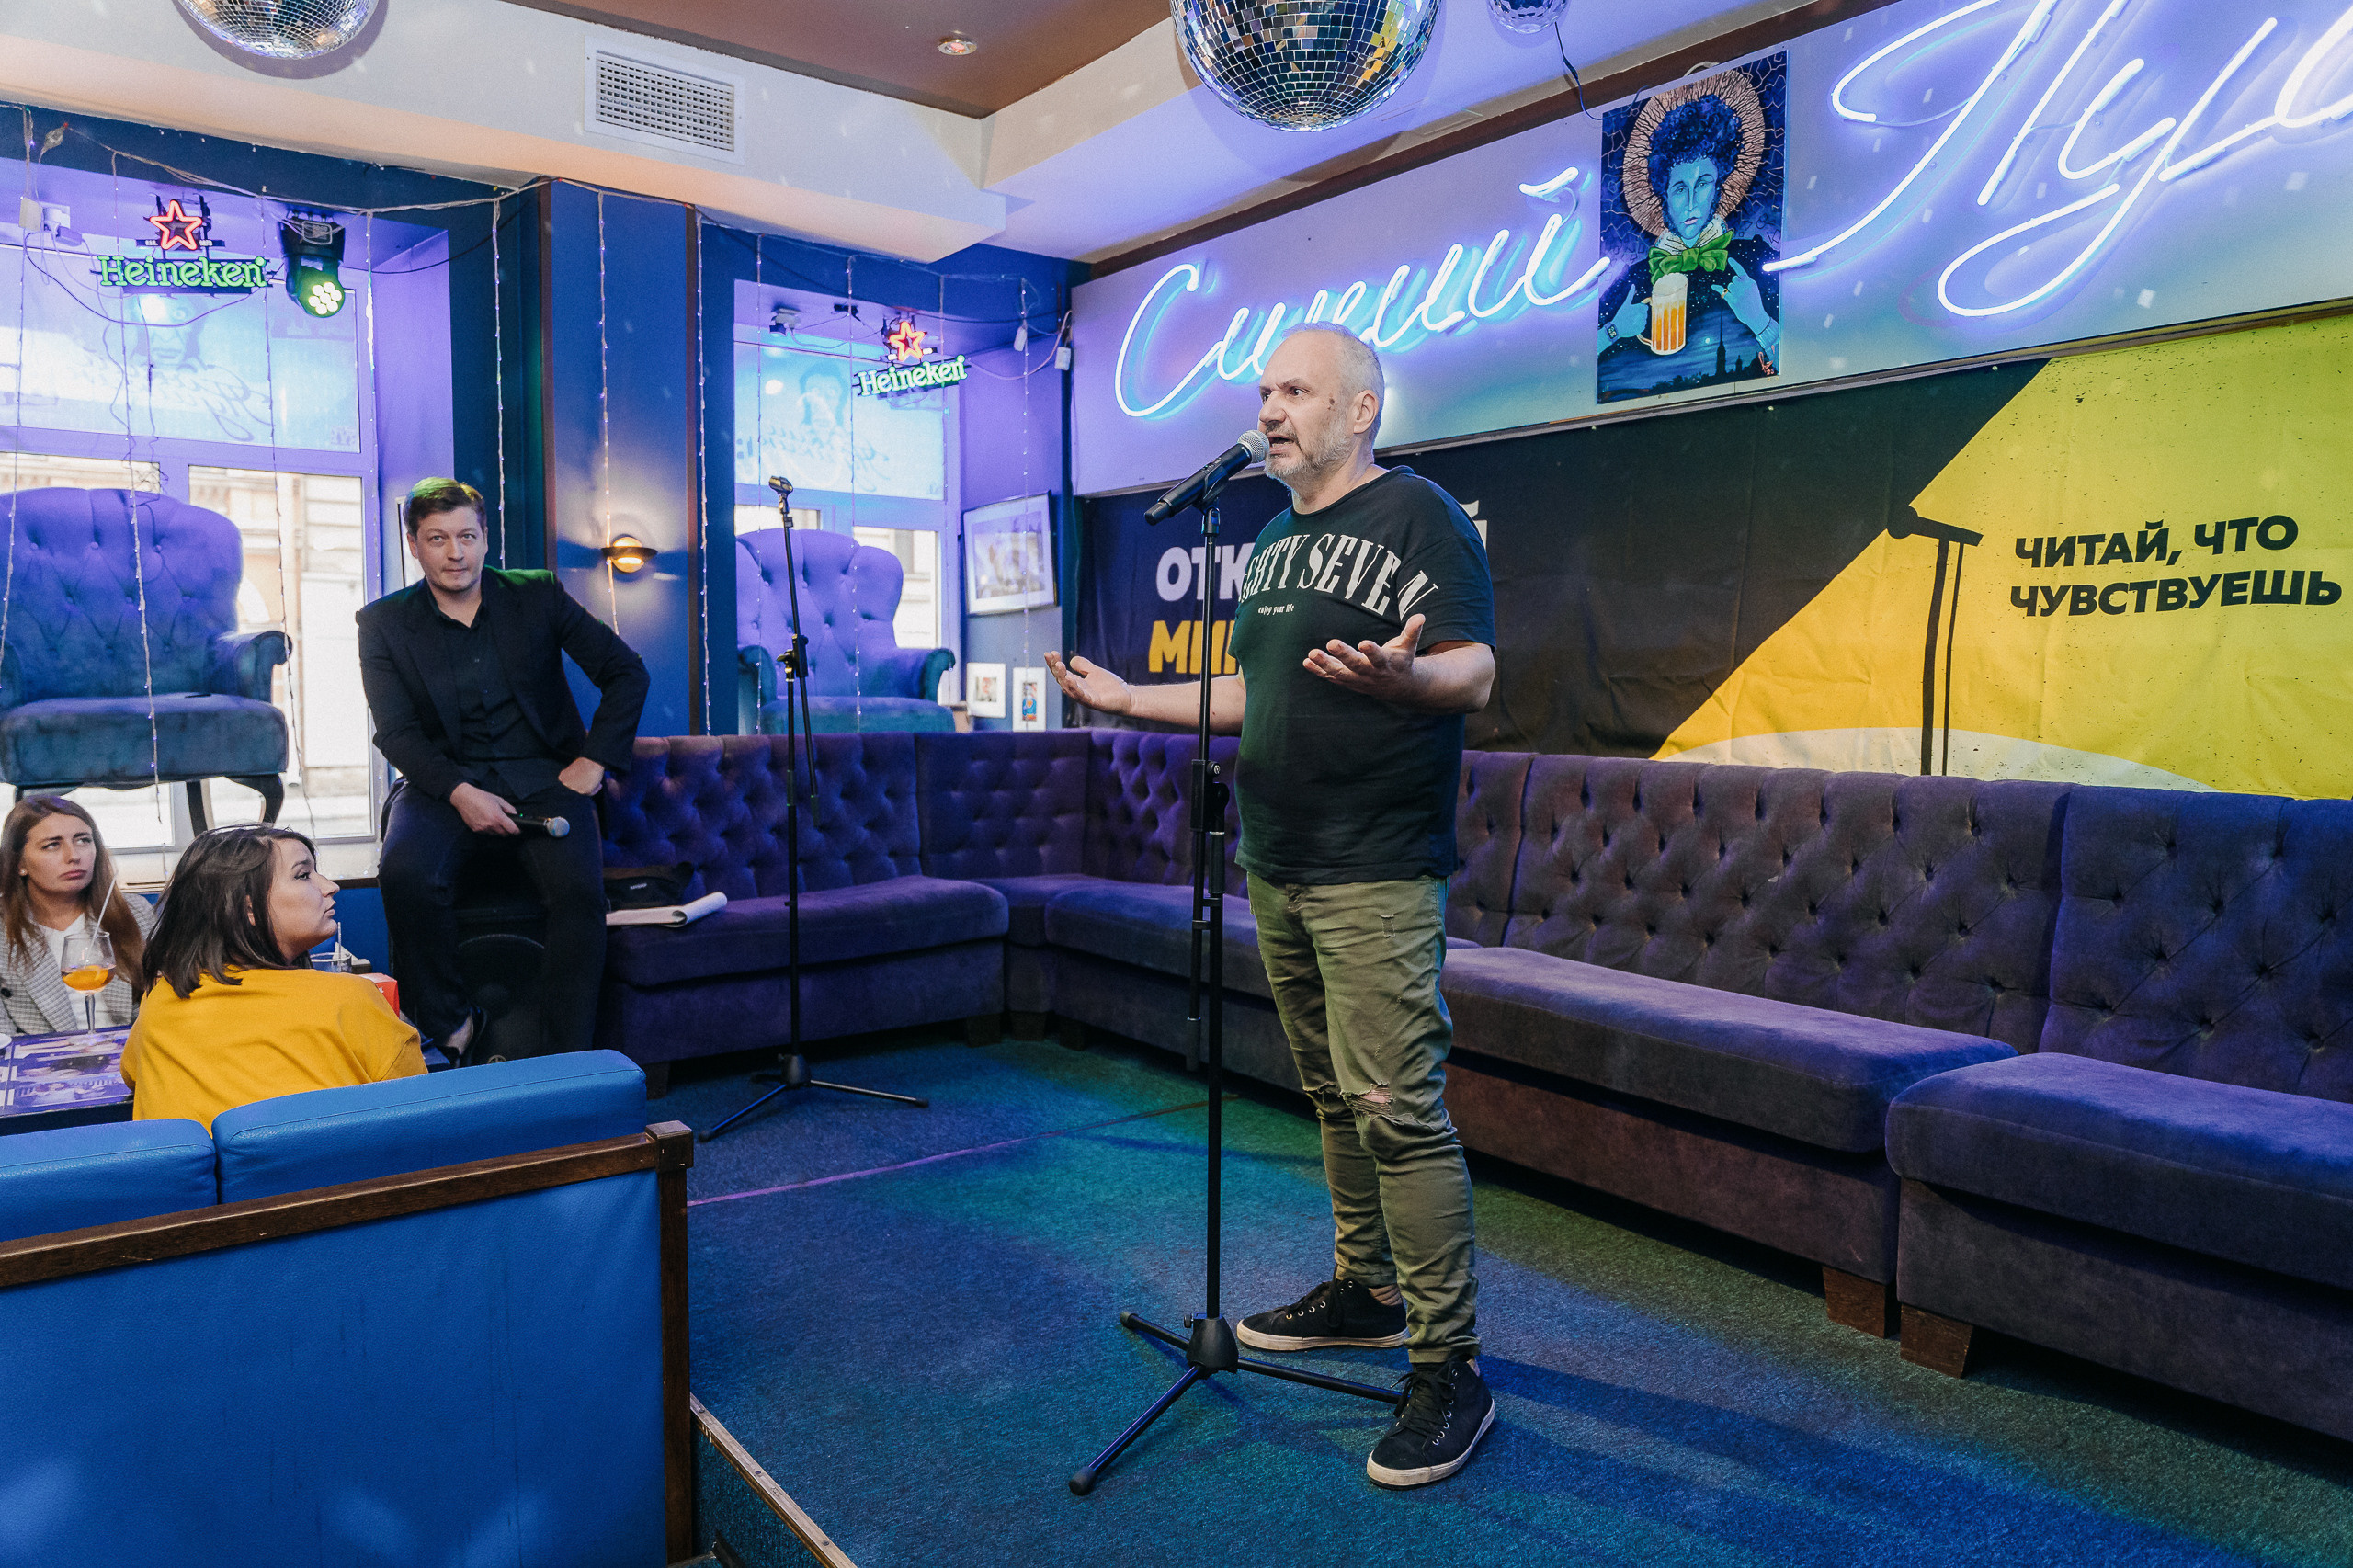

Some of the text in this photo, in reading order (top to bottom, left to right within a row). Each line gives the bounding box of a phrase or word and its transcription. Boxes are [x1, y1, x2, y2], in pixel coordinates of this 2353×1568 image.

[97, 256, 267, 288] Heineken
[858, 355, 968, 396] Heineken
[2015, 515, 2299, 568] ЧИТАЙ, ЧТО
[1297, 533, 1439, 622] SEVEN
[2010, 570, 2343, 617] ЧУВСТВУЕШЬ
